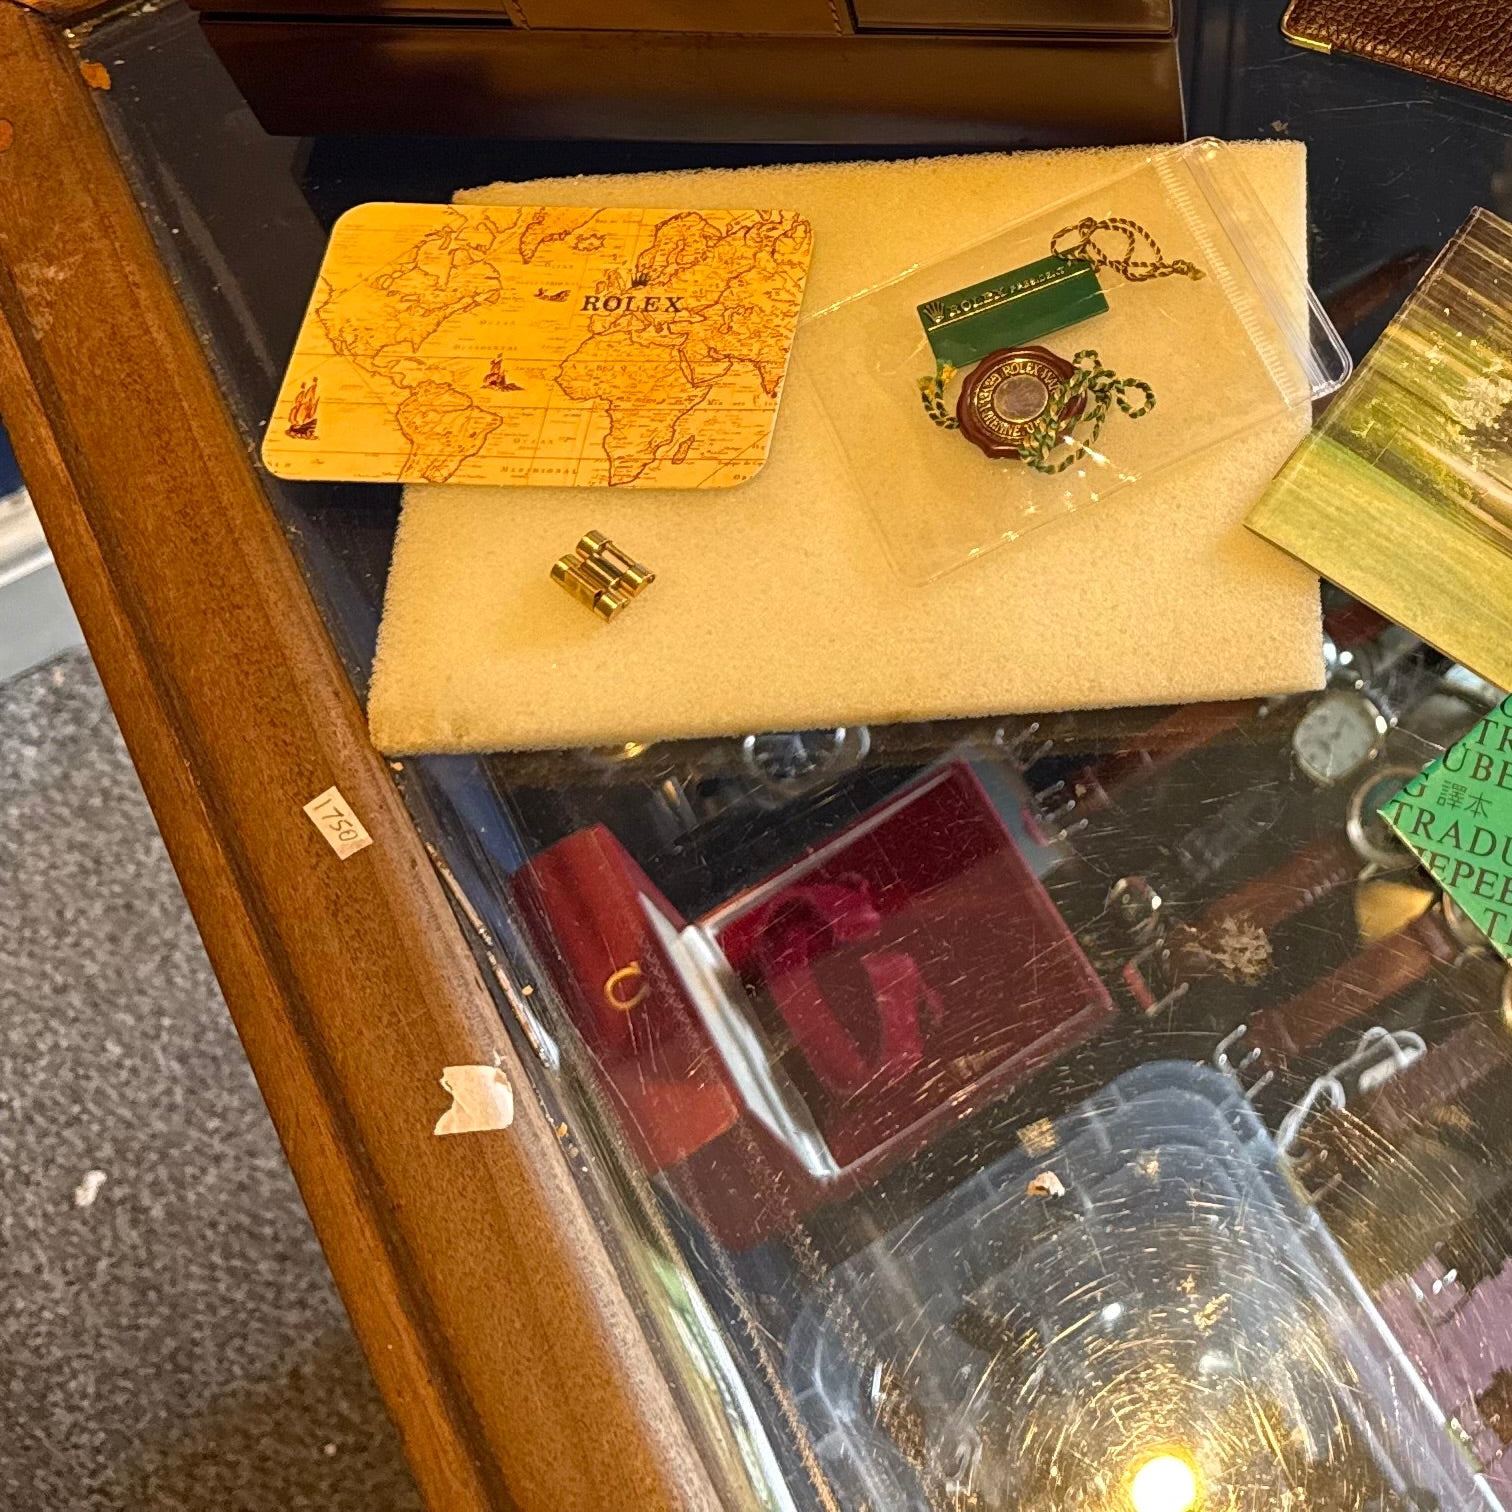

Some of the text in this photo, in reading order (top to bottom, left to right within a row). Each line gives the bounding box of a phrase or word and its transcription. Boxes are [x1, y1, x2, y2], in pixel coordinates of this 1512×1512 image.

[580, 295, 684, 313] ROLEX
[949, 286, 1008, 318] ROLEX
[1002, 361, 1042, 376] ROLEX
[312, 797, 359, 843] 1750
